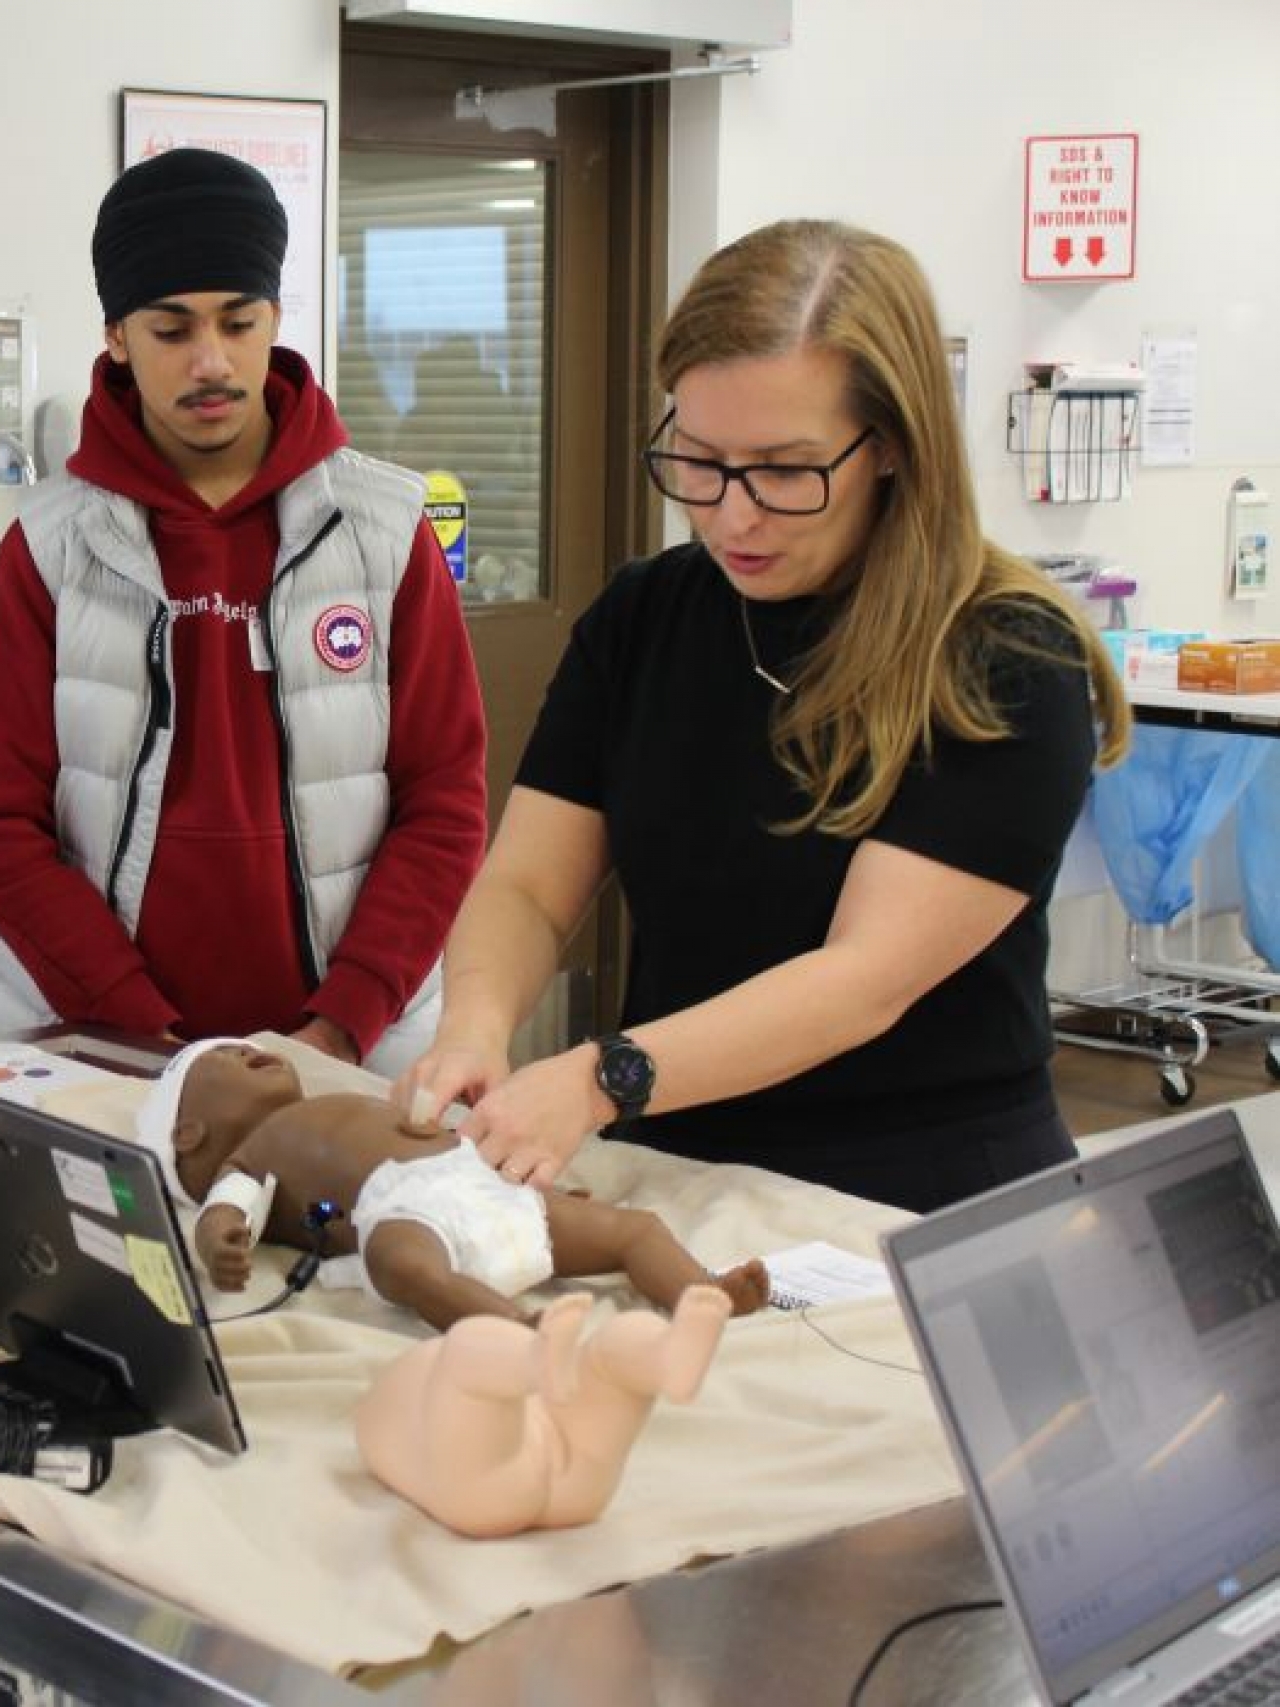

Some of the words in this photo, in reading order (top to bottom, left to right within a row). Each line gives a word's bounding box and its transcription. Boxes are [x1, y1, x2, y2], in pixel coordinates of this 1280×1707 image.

[1060, 147, 1086, 162] SDS
[1050, 168, 1089, 183] RIGHT
[1097, 167, 1113, 183] TO
[1060, 189, 1100, 205] KNOW
[1033, 209, 1128, 227] INFORMATION
